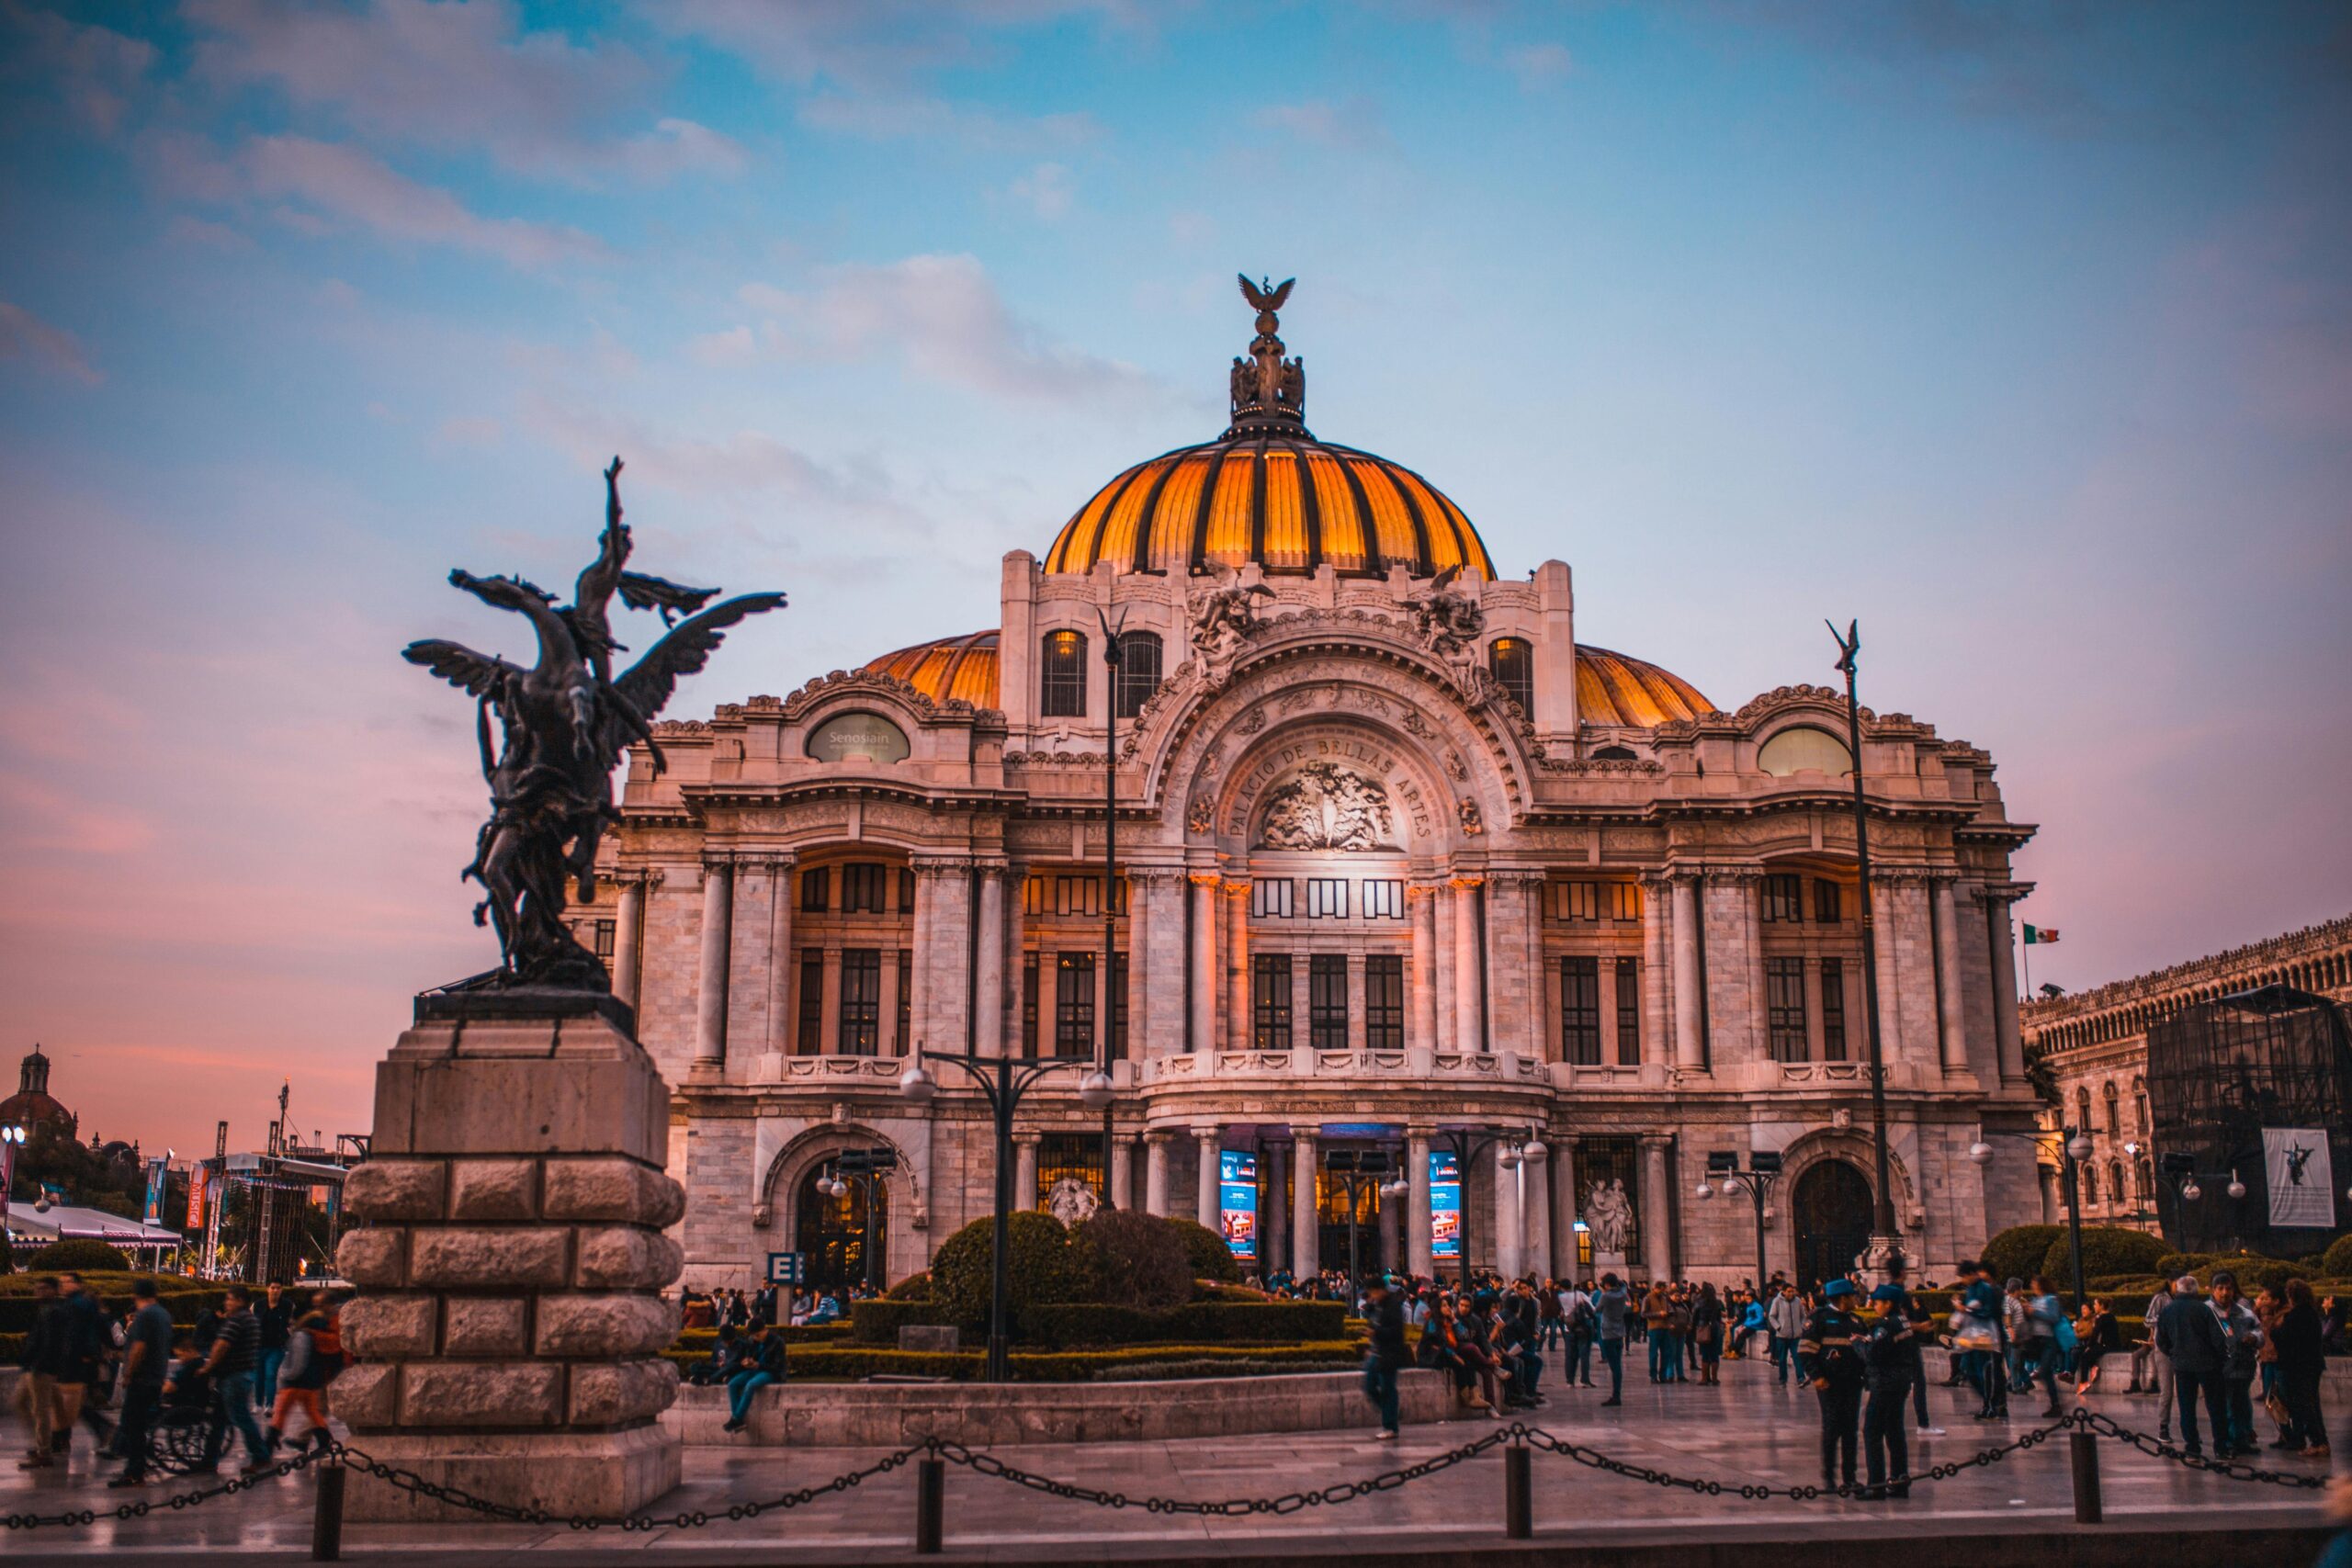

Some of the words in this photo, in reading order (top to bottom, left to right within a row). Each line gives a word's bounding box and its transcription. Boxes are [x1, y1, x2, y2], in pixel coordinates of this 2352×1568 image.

[829, 731, 889, 743] Senosiain
[1229, 761, 1275, 837] PALACIO
[1281, 744, 1307, 764] DE
[1317, 739, 1393, 773] BELLAS
[1396, 778, 1430, 838] ARTES
[773, 1257, 791, 1280] E
